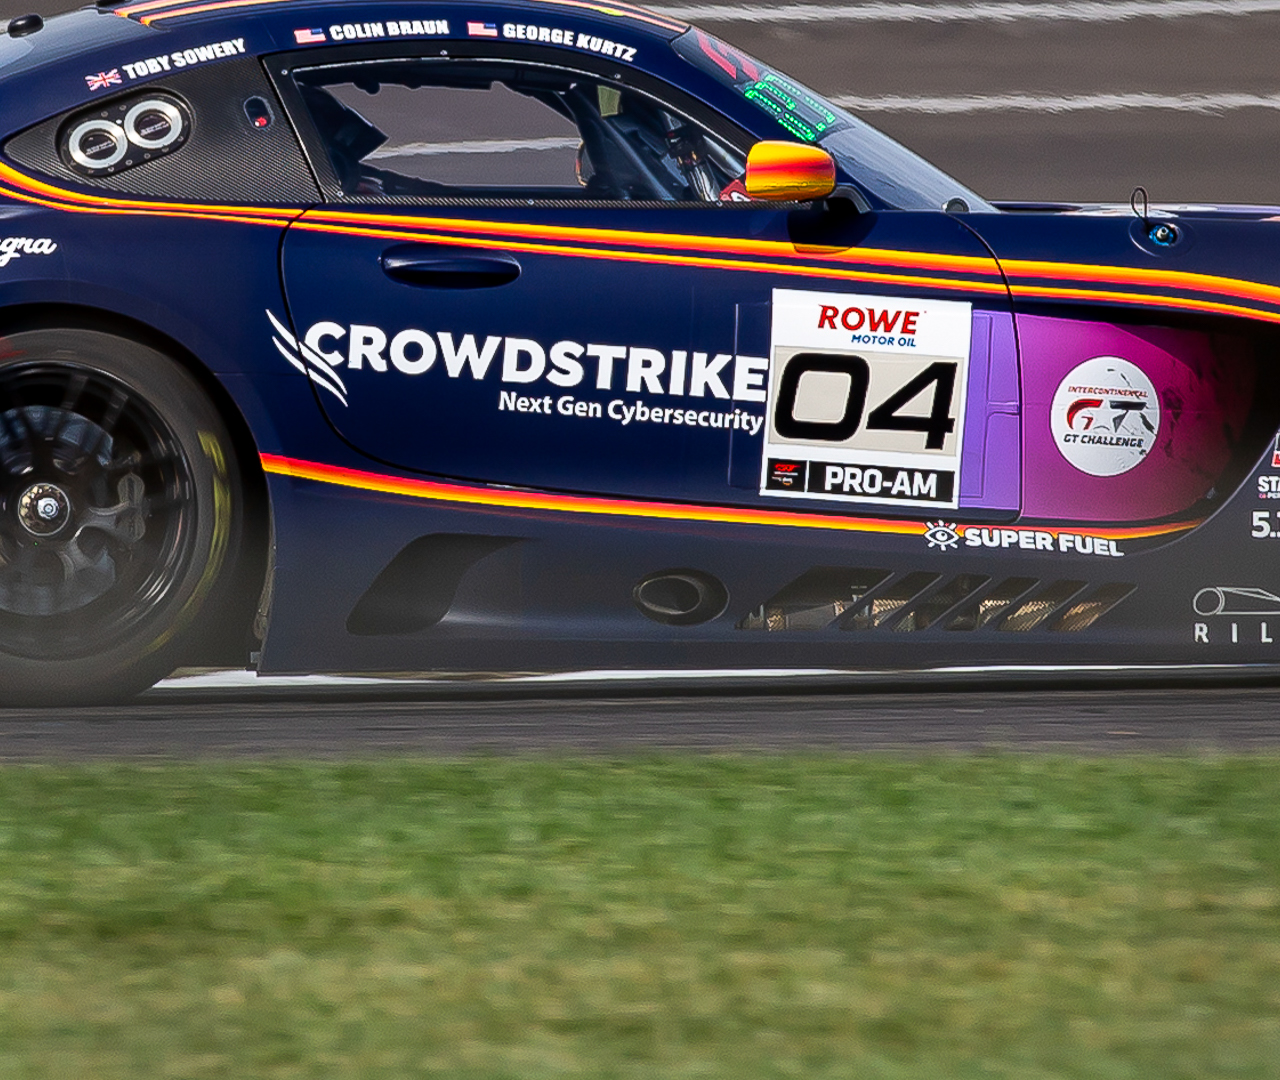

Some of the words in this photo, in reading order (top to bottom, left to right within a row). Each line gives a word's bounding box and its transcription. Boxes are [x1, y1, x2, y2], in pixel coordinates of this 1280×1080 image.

[329, 24, 387, 41] COLIN
[388, 20, 450, 36] BRAUN
[503, 23, 574, 46] GEORGE
[576, 34, 637, 62] KURTZ
[122, 55, 172, 80] TOBY
[173, 38, 246, 68] SOWERY
[817, 304, 919, 335] ROWE
[851, 334, 895, 346] MOTOR
[897, 337, 917, 348] OIL
[302, 321, 770, 403] CROWDSTRIKE
[774, 352, 958, 450] 04
[1067, 386, 1148, 398] INTERCONTINENTAL
[498, 390, 552, 414] Next
[556, 395, 602, 418] Gen
[607, 399, 764, 436] Cybersecurity
[1063, 434, 1079, 444] GT
[1080, 436, 1145, 448] CHALLENGE
[824, 465, 938, 498] PRO-AM
[965, 528, 1055, 551] SUPER
[1058, 533, 1125, 557] FUEL
